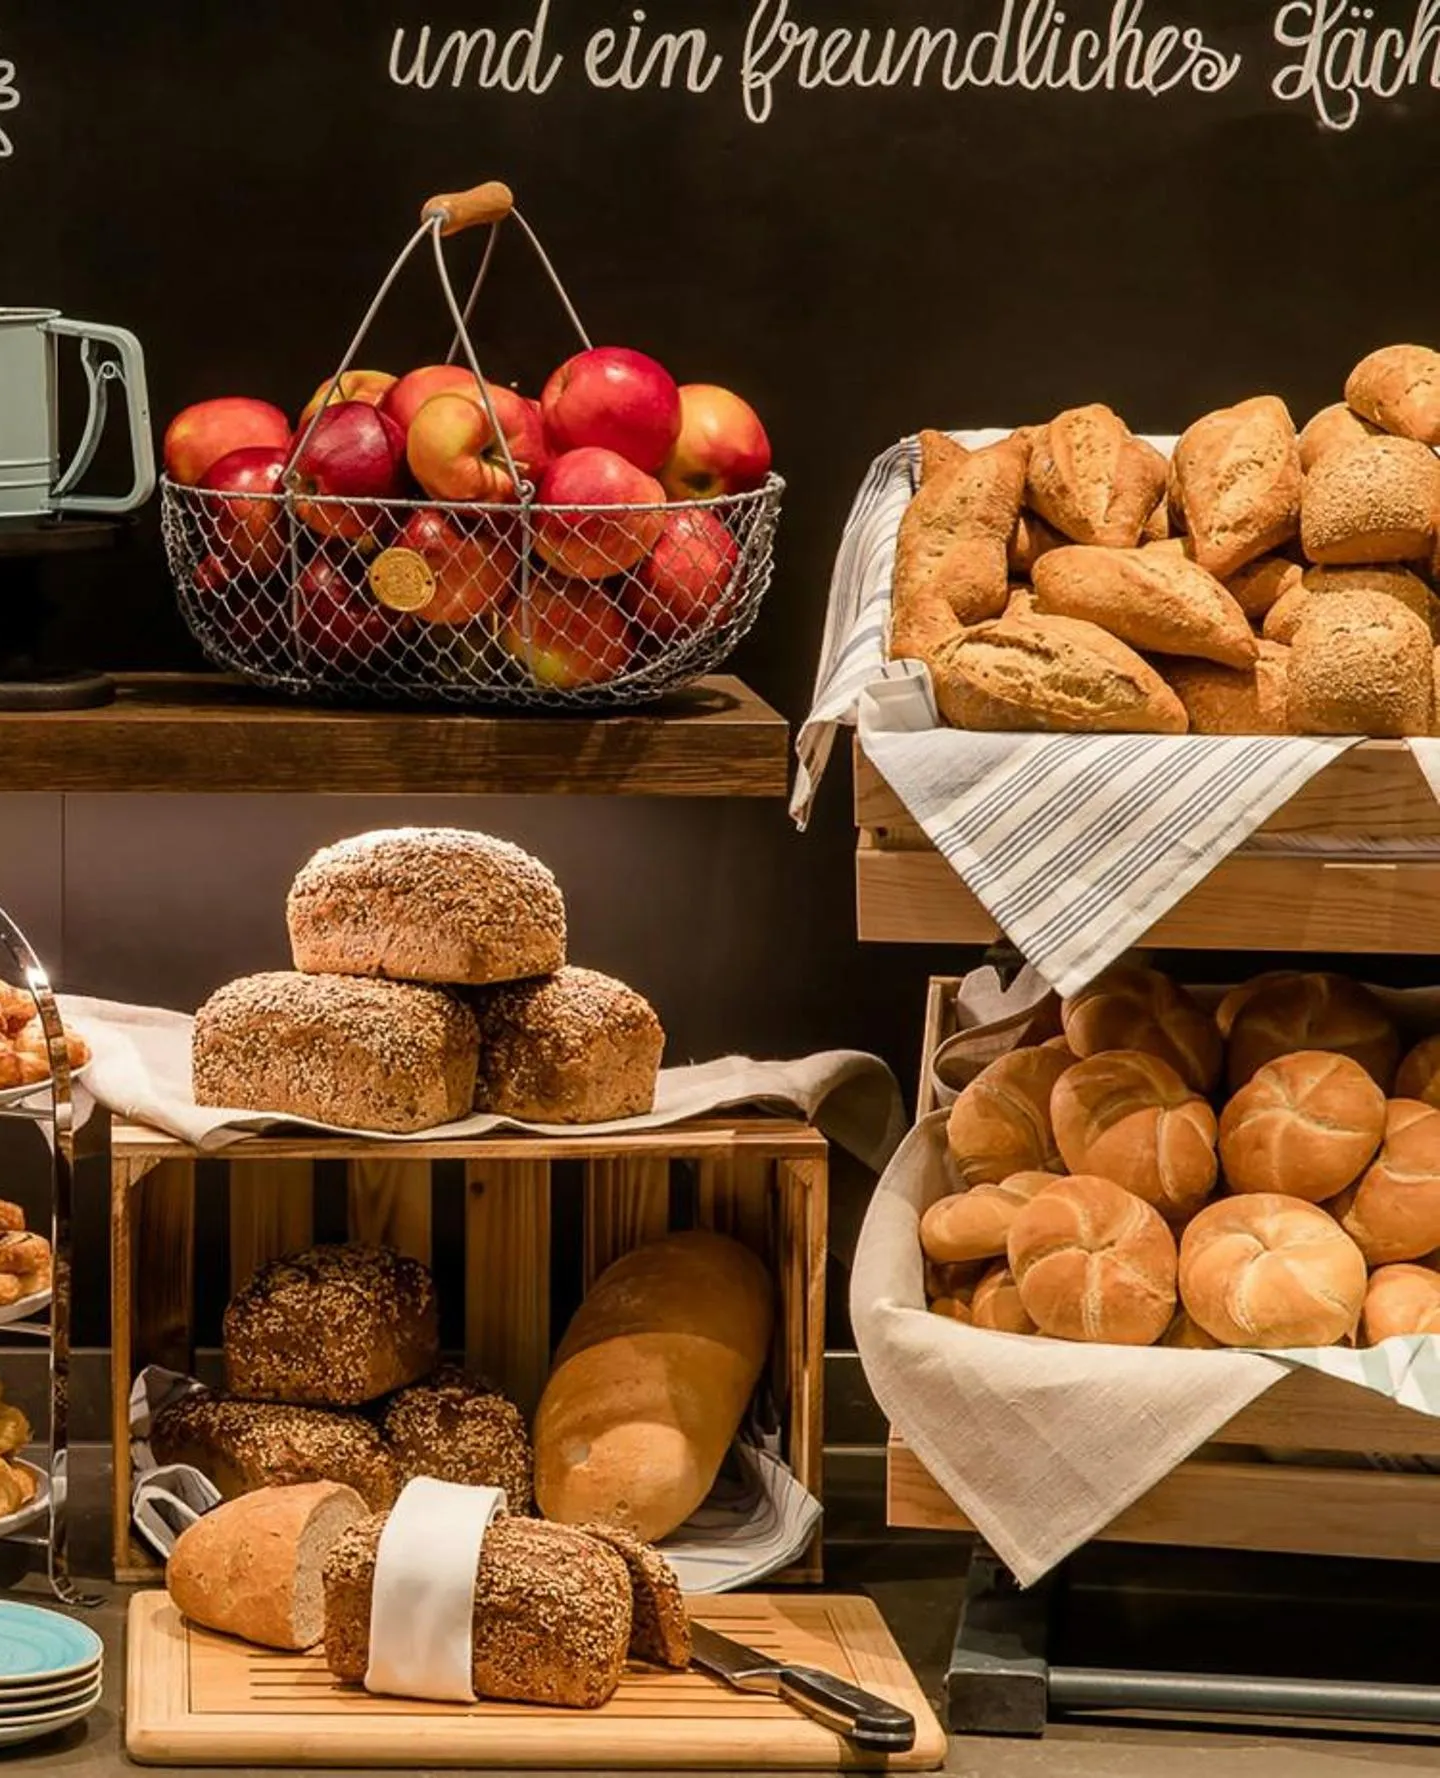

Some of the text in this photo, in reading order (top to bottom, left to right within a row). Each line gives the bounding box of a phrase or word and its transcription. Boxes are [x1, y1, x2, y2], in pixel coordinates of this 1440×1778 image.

[389, 0, 563, 94] und
[585, 9, 723, 94] ein
[741, 0, 1241, 123] freundliches
